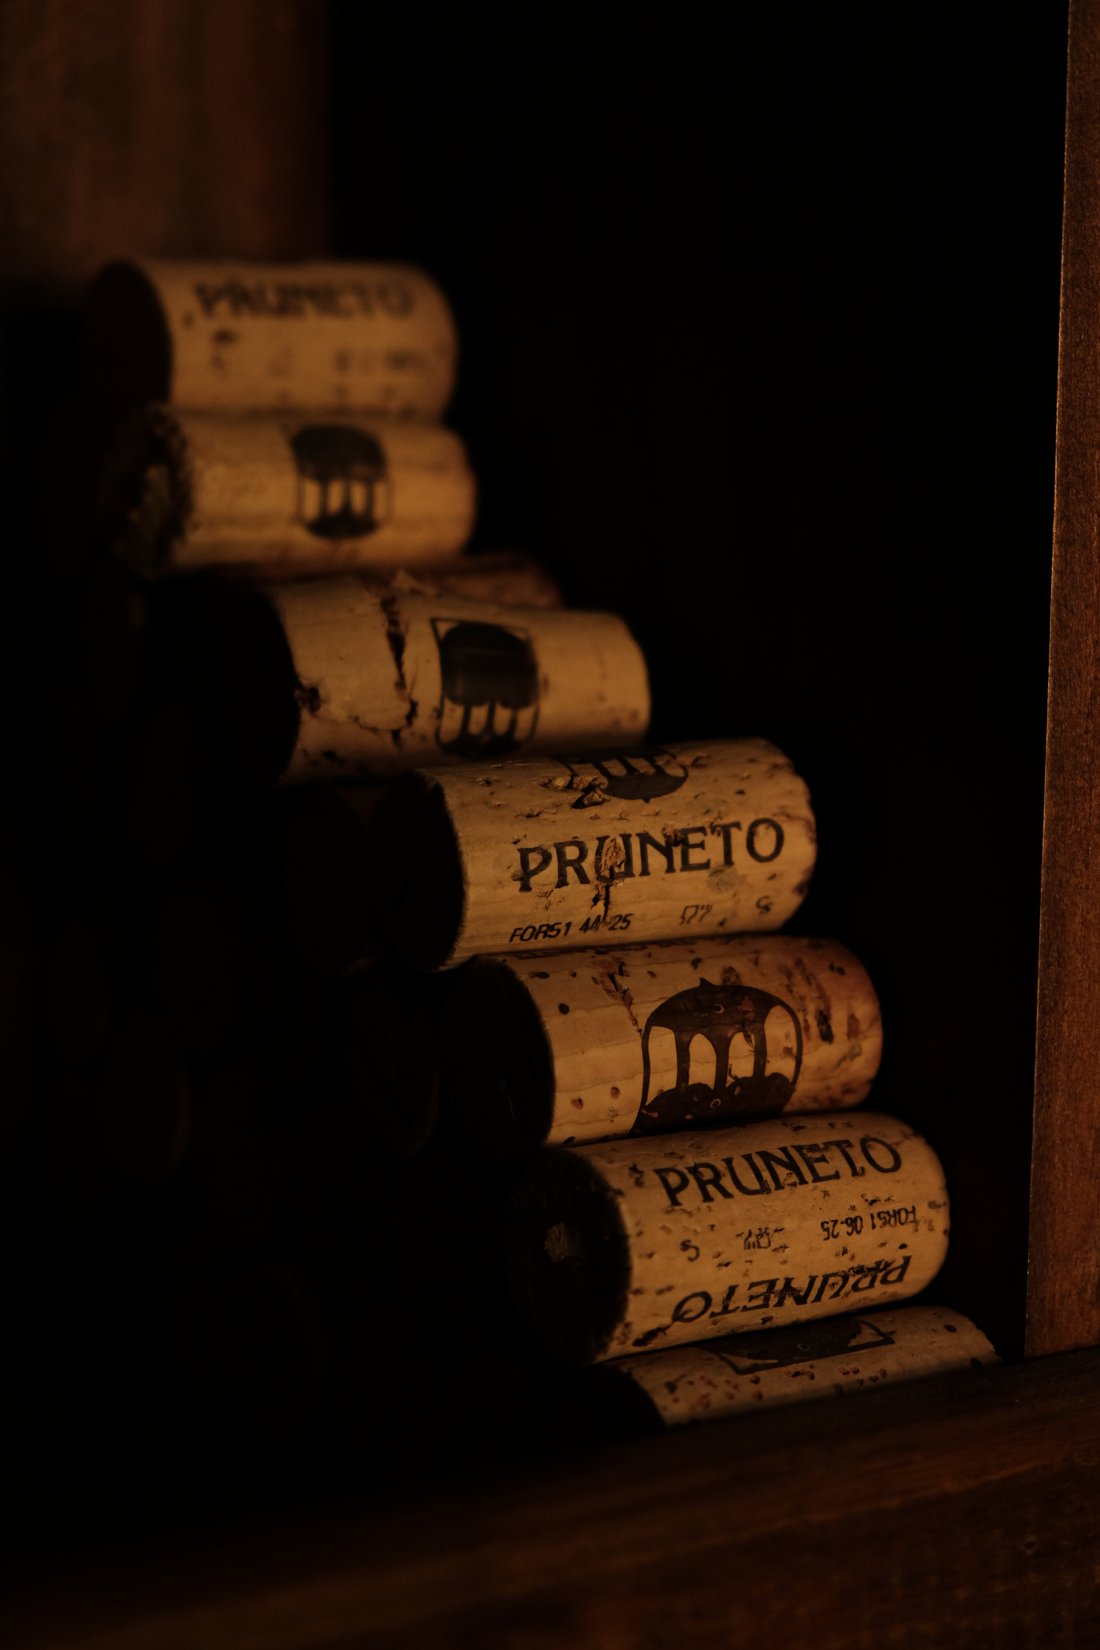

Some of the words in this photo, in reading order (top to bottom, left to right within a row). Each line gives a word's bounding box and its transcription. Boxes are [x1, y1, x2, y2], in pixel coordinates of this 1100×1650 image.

[516, 818, 784, 892] PRUNETO
[654, 1137, 902, 1206] PRUNETO
[671, 1255, 912, 1323] PRUNETO
